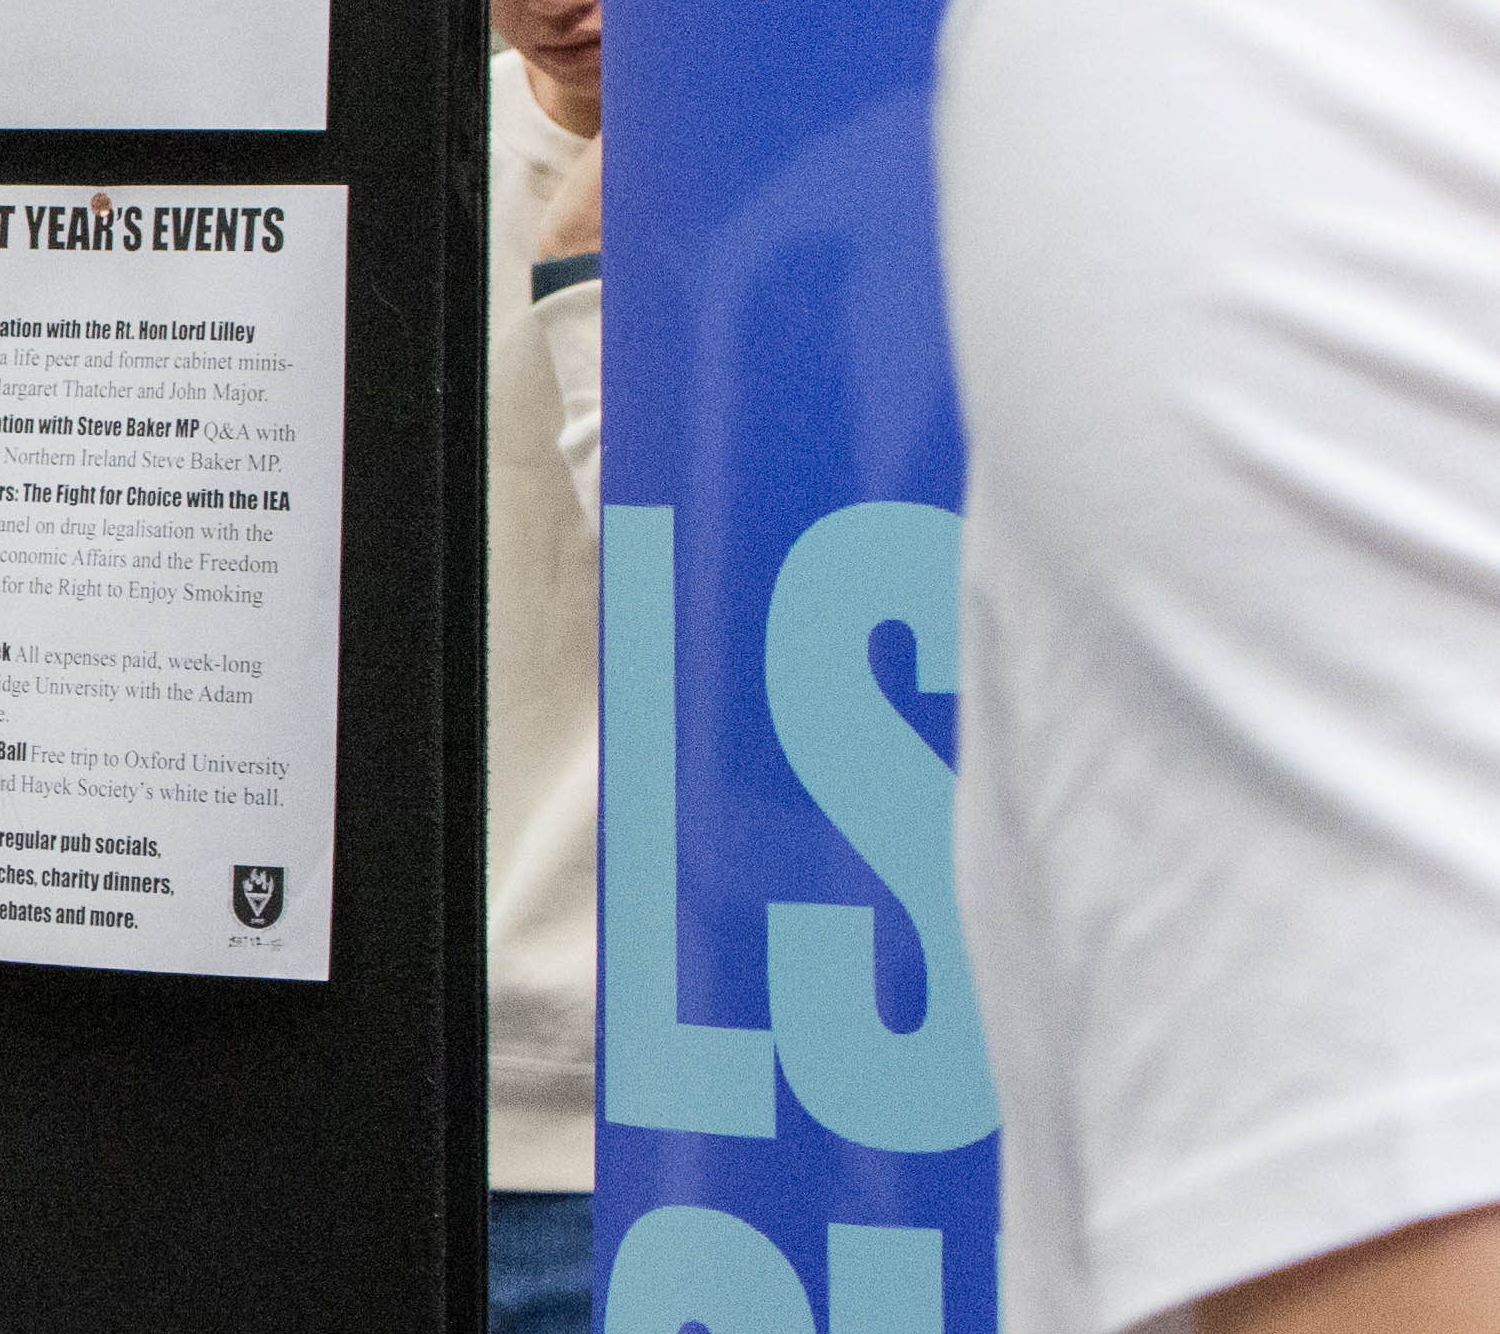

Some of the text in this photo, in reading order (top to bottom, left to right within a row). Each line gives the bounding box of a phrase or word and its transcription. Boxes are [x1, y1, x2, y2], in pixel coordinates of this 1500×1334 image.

[24, 206, 142, 250] YEAR'S
[152, 207, 284, 251] EVENTS
[45, 318, 81, 338] with
[84, 319, 112, 340] the
[114, 319, 135, 340] Rt.
[138, 319, 168, 340] Hon
[170, 320, 207, 341] Lord
[209, 320, 255, 344] Lilley
[13, 347, 41, 366] life
[43, 353, 81, 371] peer
[83, 349, 114, 368] and
[117, 349, 171, 369] former
[172, 350, 233, 370] cabinet
[237, 352, 294, 372] minis-
[61, 378, 134, 399] Thatcher
[135, 381, 165, 399] and
[167, 380, 207, 400] John
[211, 382, 269, 406] Major.
[37, 415, 73, 435] with
[76, 415, 122, 436] Steve
[125, 416, 172, 437] Baker
[174, 418, 200, 438] MP
[202, 420, 251, 443] Q&A
[255, 423, 296, 442] with
[3, 446, 76, 466] Northern
[80, 448, 137, 468] Ireland
[141, 450, 185, 469] Steve
[189, 451, 243, 471] Baker
[246, 453, 282, 472] MP.
[21, 482, 52, 503] The
[55, 483, 97, 506] Fight
[99, 484, 123, 505] for
[125, 485, 183, 507] Choice
[185, 488, 224, 508] with
[228, 489, 259, 510] the
[262, 490, 291, 511] IEA
[34, 520, 55, 534] on
[59, 516, 97, 541] drug
[101, 518, 195, 542] legalisation
[199, 522, 239, 541] with
[245, 522, 274, 542] the
[70, 547, 127, 568] Affairs
[131, 550, 162, 569] and
[166, 551, 194, 570] the
[198, 552, 279, 574] Freedom
[1, 574, 25, 594] for
[28, 576, 53, 595] the
[57, 577, 102, 601] Right
[106, 582, 123, 598] to
[127, 580, 178, 605] Enjoy
[181, 582, 264, 609] Smoking
[17, 645, 39, 663] All
[43, 651, 117, 669] expenses
[121, 650, 162, 672] paid,
[167, 653, 262, 678] week-long
[35, 675, 120, 702] University
[124, 680, 161, 699] with
[166, 682, 194, 701] the
[197, 684, 253, 704] Adam
[30, 744, 66, 764] Free
[69, 747, 99, 771] trip
[103, 751, 120, 767] to
[123, 749, 186, 771] Oxford
[191, 753, 290, 780] University
[20, 774, 72, 798] Hayek
[77, 777, 154, 803] Society's
[158, 783, 209, 803] white
[213, 785, 238, 804] tie
[243, 786, 285, 807] ball.
[602, 500, 1003, 1155] LS
[59, 832, 91, 853] pub
[94, 835, 162, 857] socials,
[40, 867, 100, 891] charity
[102, 870, 175, 895] dinners,
[54, 905, 86, 925] and
[89, 909, 139, 929] more.
